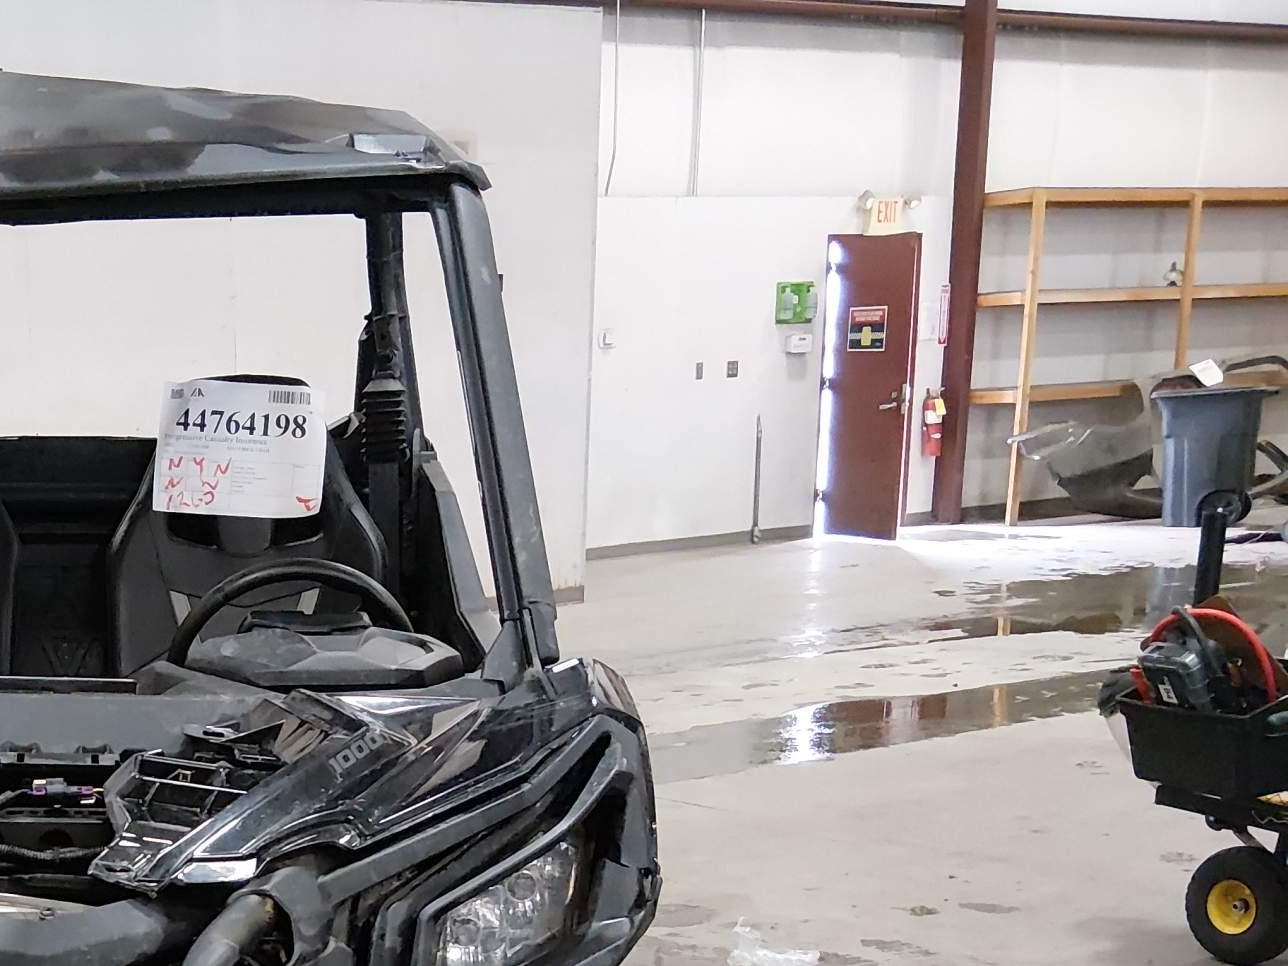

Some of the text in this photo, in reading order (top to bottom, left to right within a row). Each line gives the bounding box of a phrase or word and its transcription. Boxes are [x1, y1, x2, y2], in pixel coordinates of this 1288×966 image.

[877, 201, 899, 224] EXIT
[175, 408, 308, 439] 44764198
[328, 731, 385, 773] 1000
